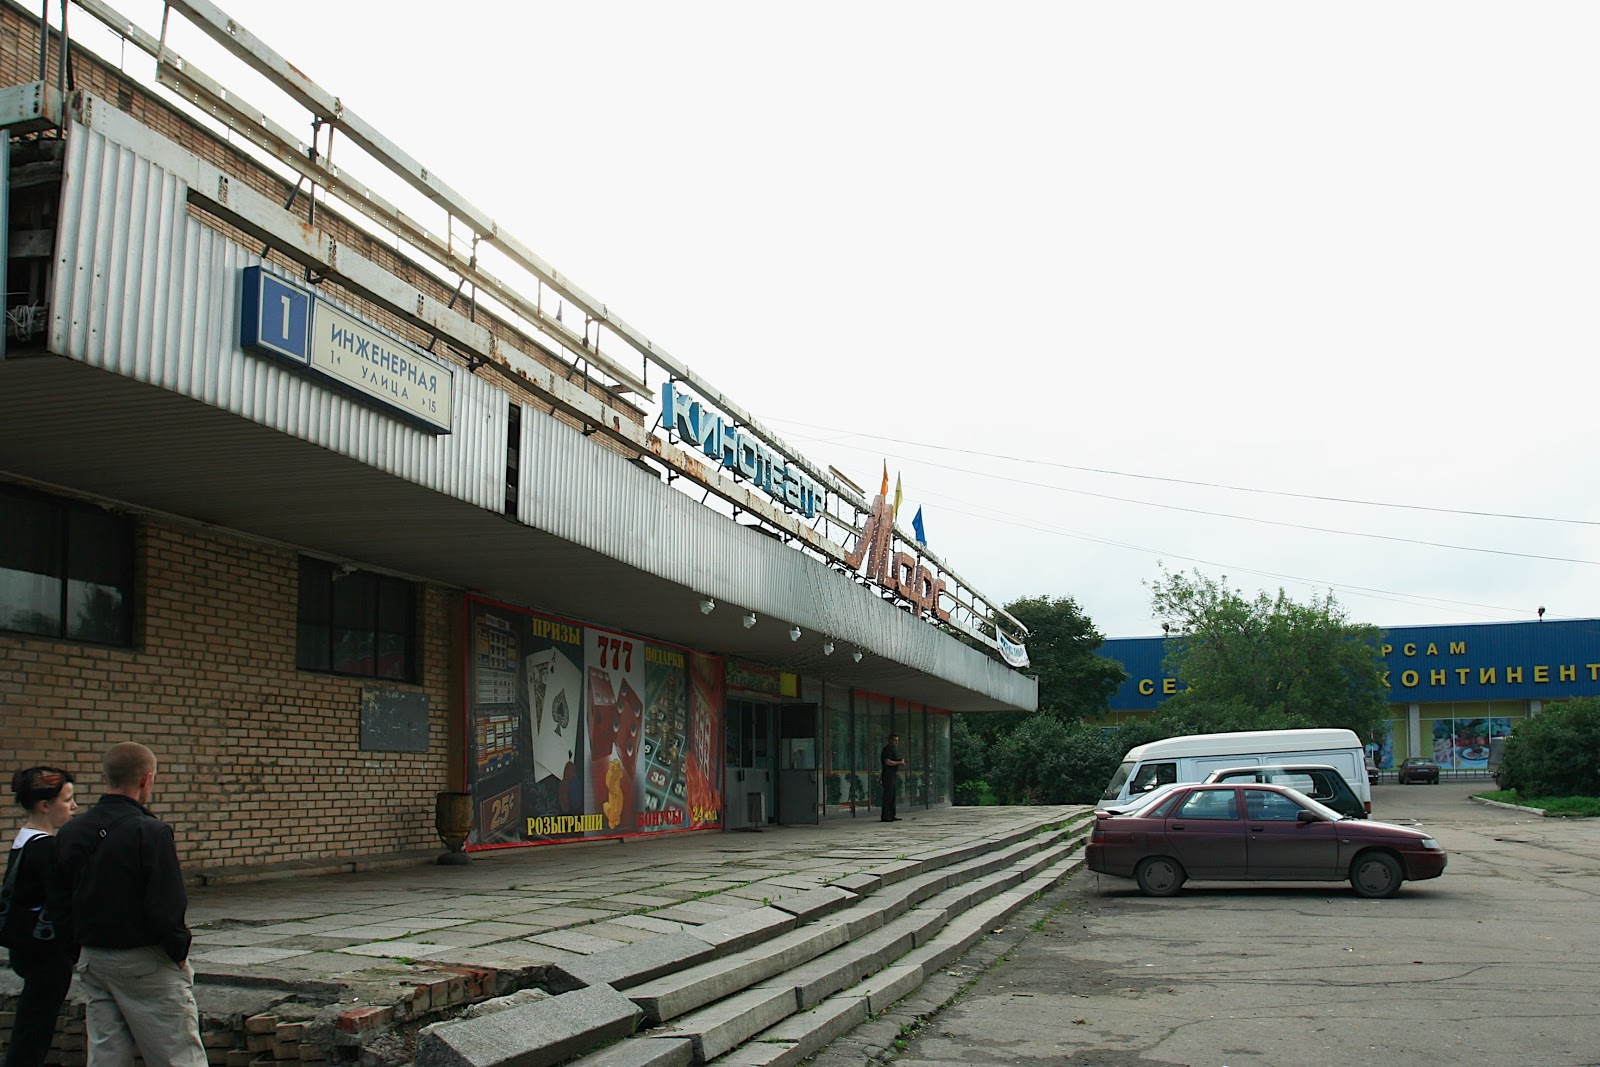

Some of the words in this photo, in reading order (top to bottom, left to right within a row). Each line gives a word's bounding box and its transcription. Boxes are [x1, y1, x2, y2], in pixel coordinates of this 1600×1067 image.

[281, 295, 291, 340] 1
[331, 323, 437, 394] ИНЖЕНЕРНАЯ
[361, 365, 409, 399] УЛИЦА
[428, 399, 437, 413] 15
[532, 618, 581, 645] ПРИЗЫ
[598, 636, 633, 673] 777
[645, 647, 685, 668] ПОДАРКИ
[1381, 641, 1466, 657] РСАМ
[1378, 663, 1600, 688] КОНТИНЕНТ
[526, 814, 603, 836] РОЗЫГРЫШИ
[637, 810, 682, 828] БОНУСЫ
